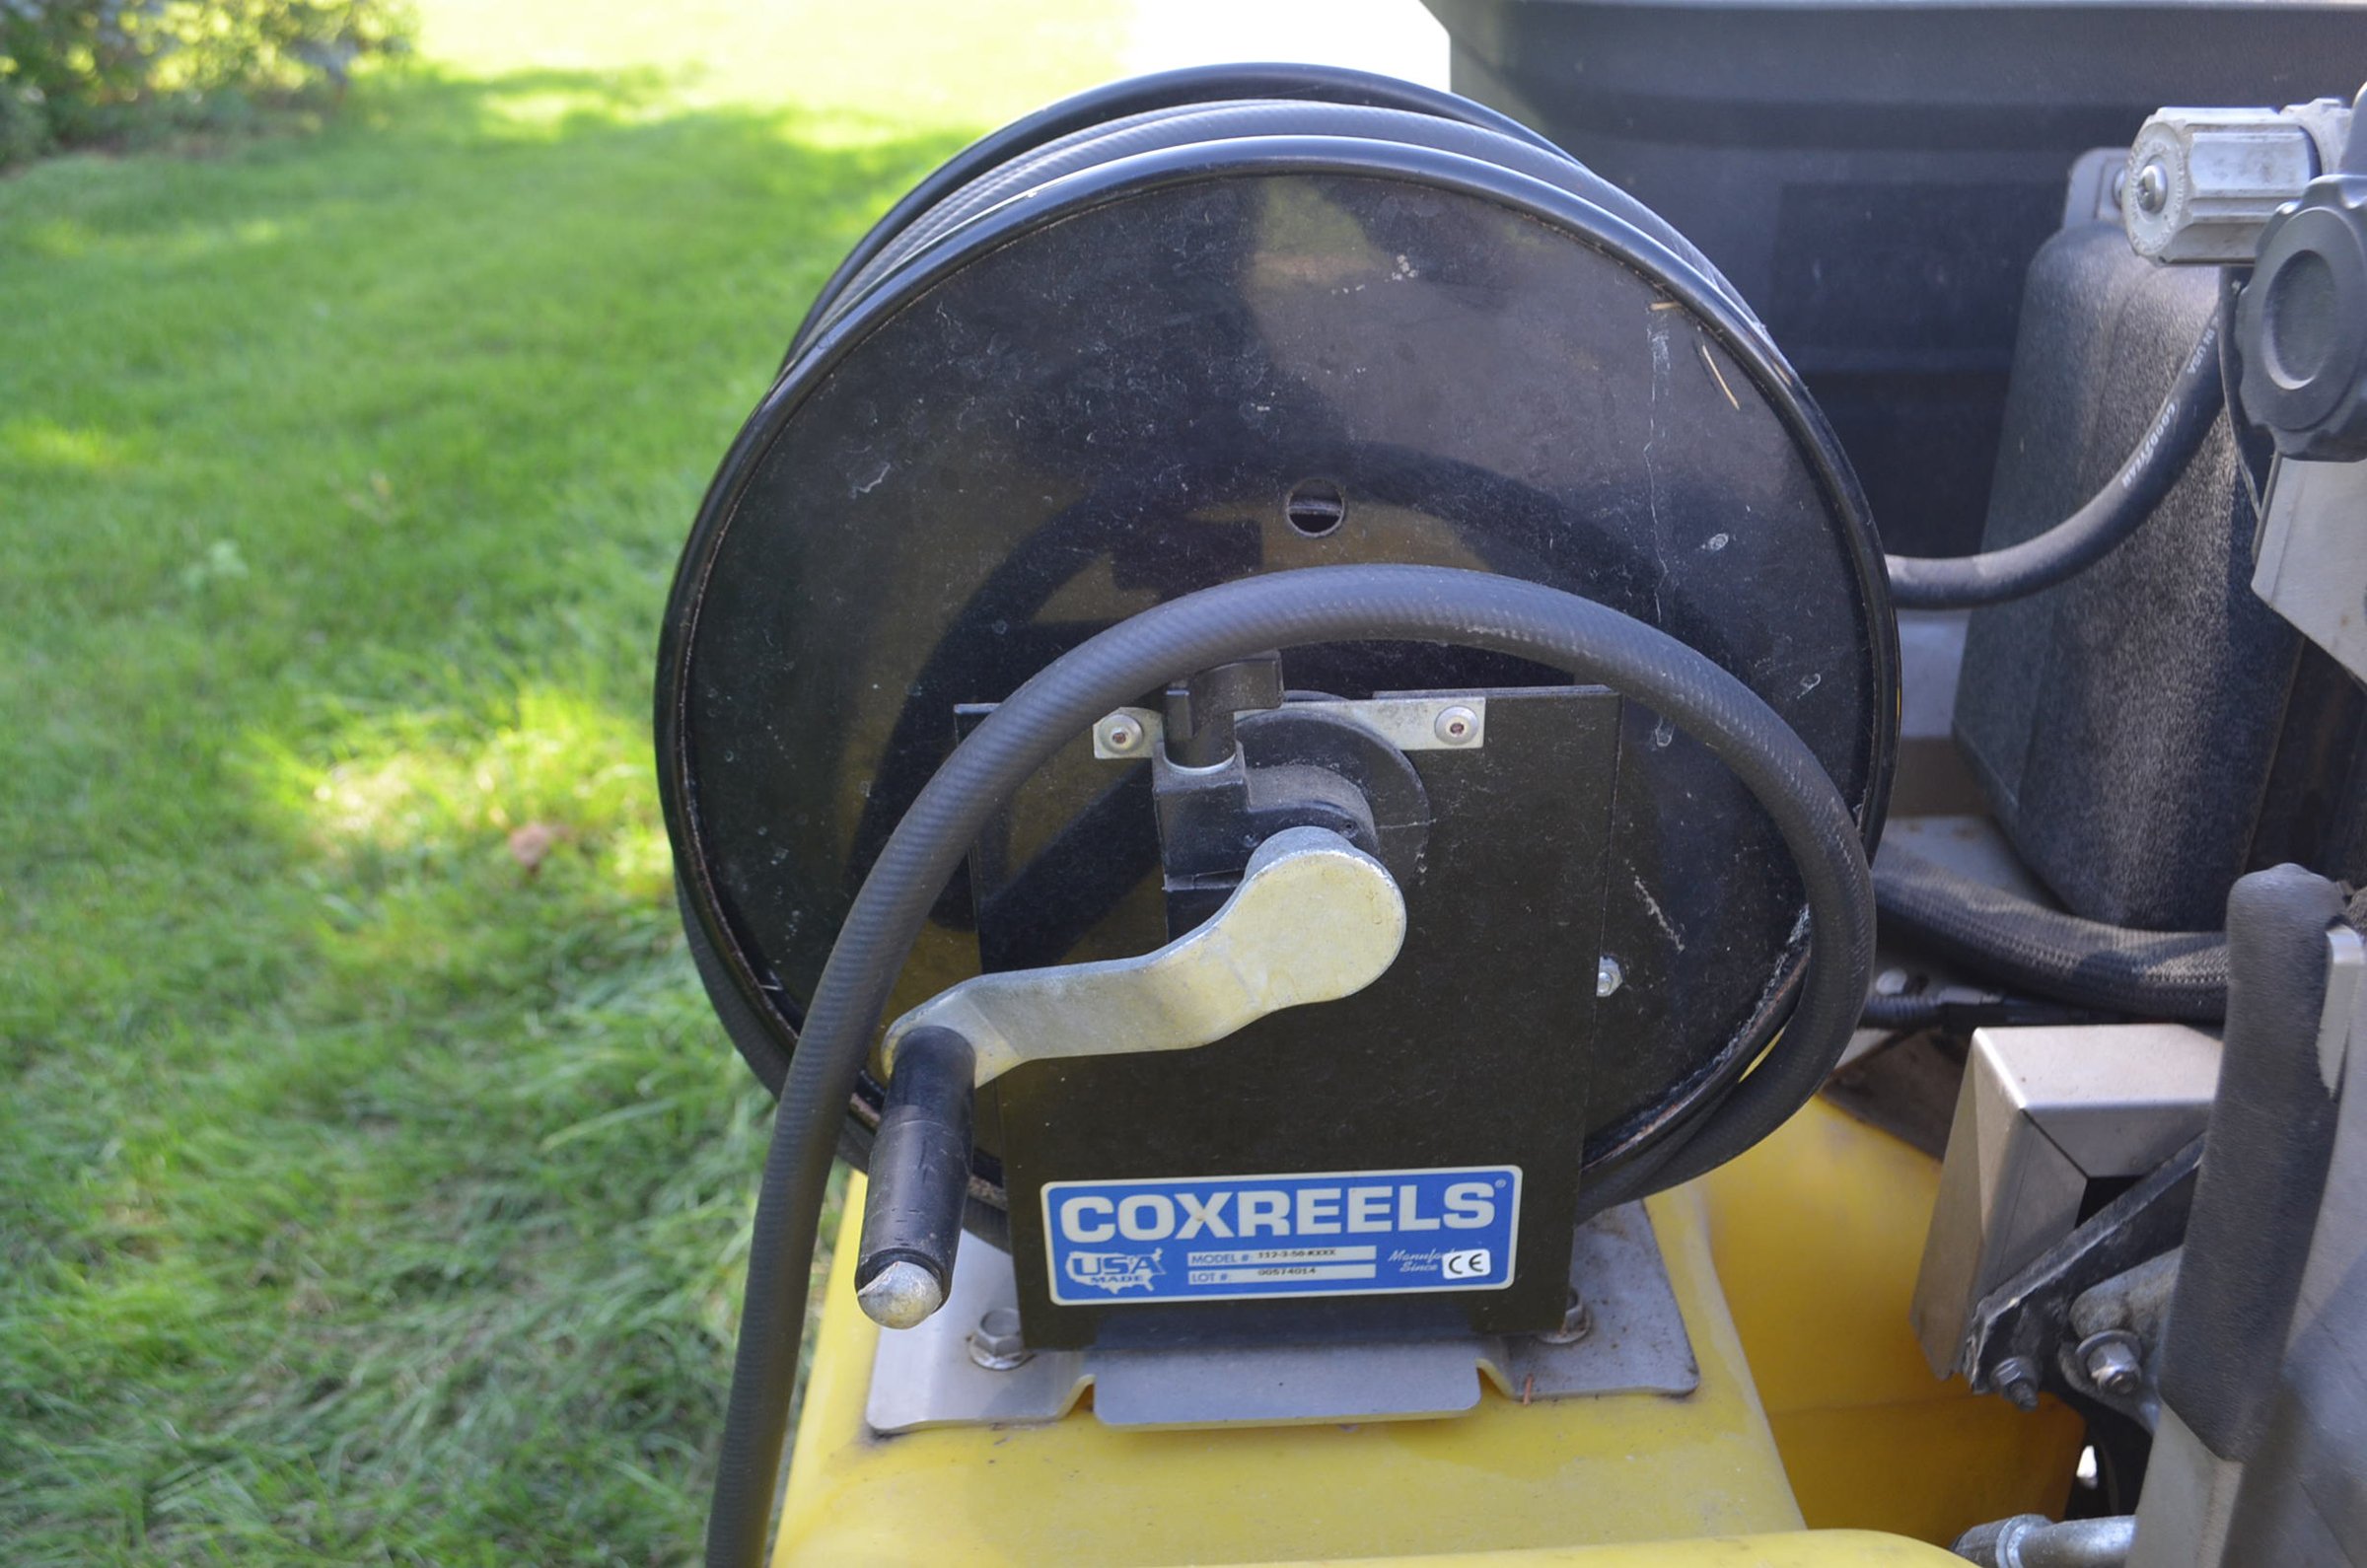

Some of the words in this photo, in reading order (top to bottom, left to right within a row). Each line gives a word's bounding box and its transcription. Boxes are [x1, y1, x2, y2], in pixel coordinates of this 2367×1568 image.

[2187, 344, 2207, 375] USA
[2121, 400, 2176, 488] GOODYEAR
[1059, 1181, 1495, 1243] COXREELS
[1072, 1254, 1167, 1276] USA
[1191, 1253, 1237, 1264] MODEL
[1448, 1252, 1484, 1275] CE
[1090, 1274, 1144, 1284] MADE
[1191, 1272, 1216, 1283] LOT
